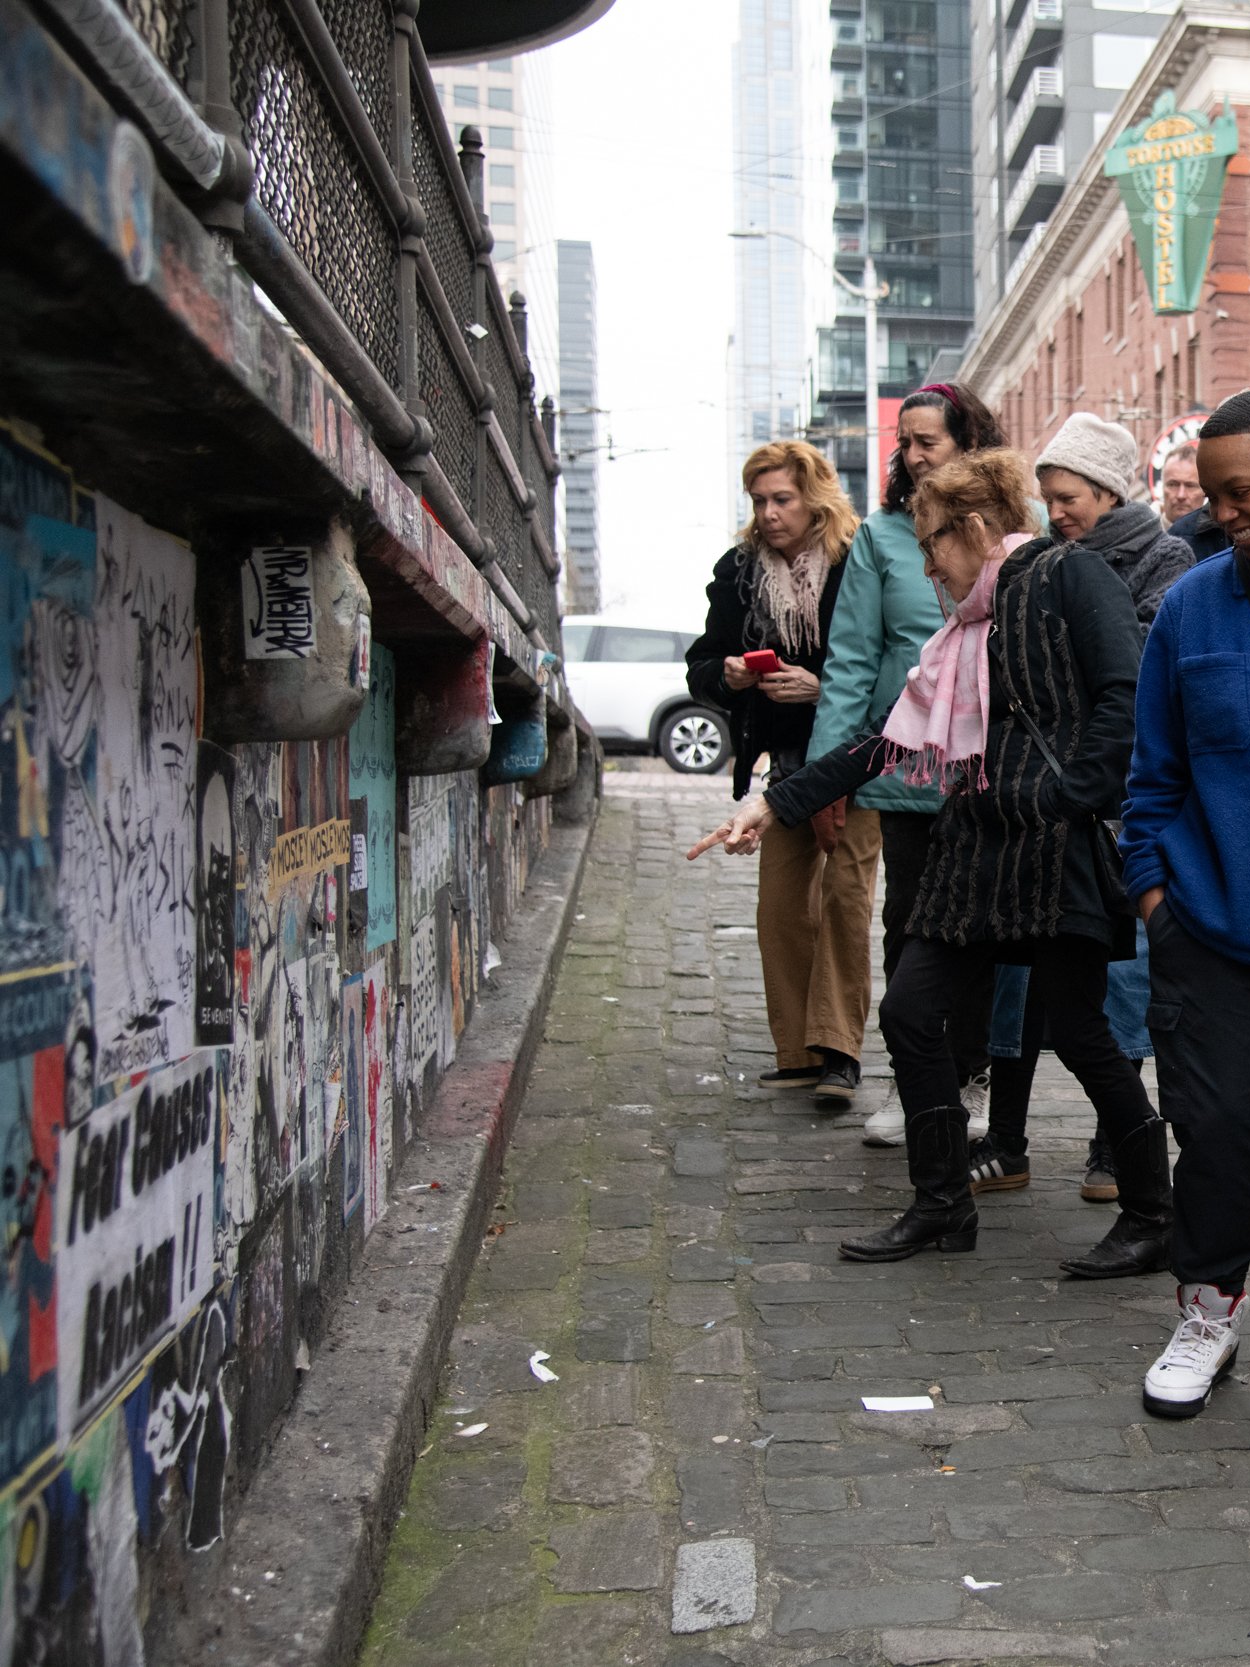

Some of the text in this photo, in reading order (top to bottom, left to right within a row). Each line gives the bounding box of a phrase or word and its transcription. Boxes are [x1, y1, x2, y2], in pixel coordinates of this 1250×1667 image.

[1126, 134, 1215, 168] TORTOISE
[1153, 163, 1177, 310] HOSTEL
[277, 830, 309, 878] MOSLEY
[309, 822, 338, 869] MOSLEY
